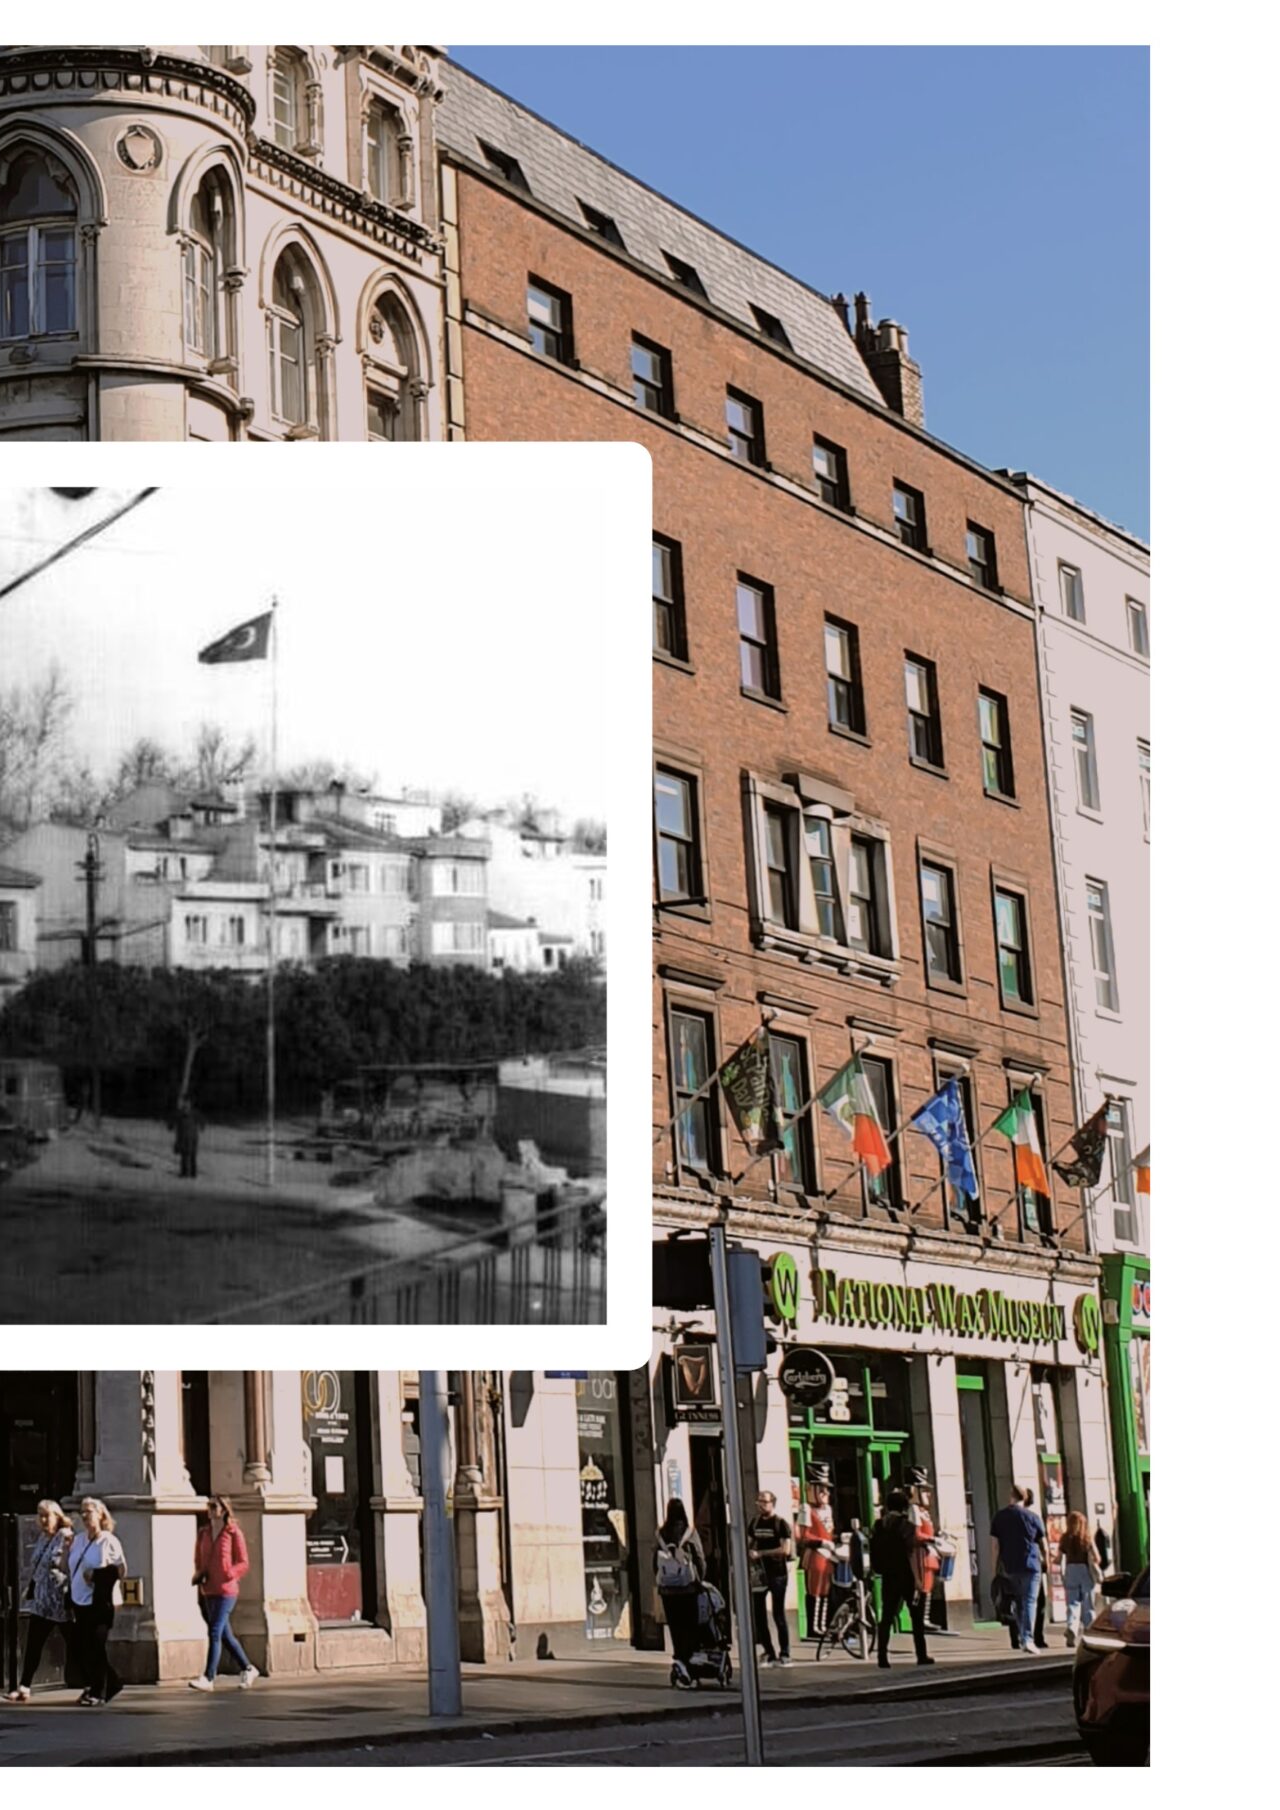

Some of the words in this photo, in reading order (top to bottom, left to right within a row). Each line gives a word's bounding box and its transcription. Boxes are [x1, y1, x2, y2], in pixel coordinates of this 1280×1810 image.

[730, 1078, 754, 1106] Day
[818, 1268, 934, 1330] NATIONAL
[934, 1283, 985, 1333] WAX
[986, 1290, 1066, 1341] MUSEUM
[783, 1368, 827, 1389] Carlsberg
[123, 1581, 138, 1602] H
